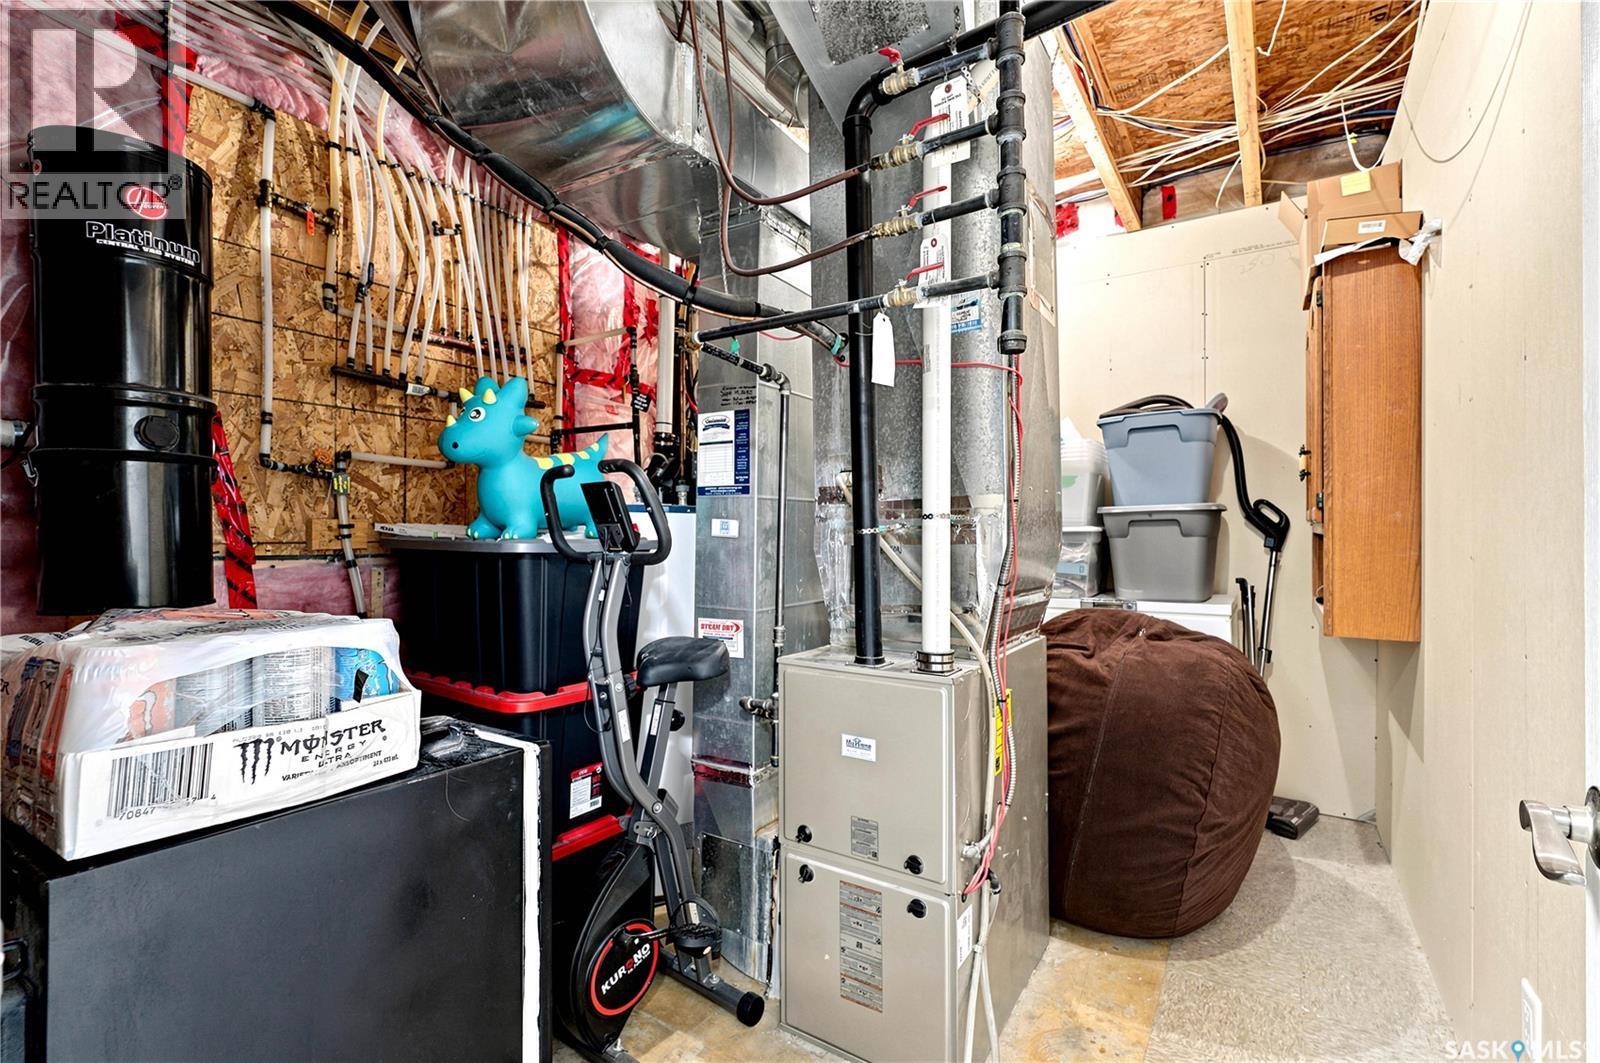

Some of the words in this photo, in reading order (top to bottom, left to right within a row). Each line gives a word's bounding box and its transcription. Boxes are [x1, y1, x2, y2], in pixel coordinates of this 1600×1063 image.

[86, 220, 200, 263] Platinum
[96, 239, 140, 251] CENTRAL
[164, 251, 195, 266] SYSTEM
[318, 752, 352, 768] UTRA
[601, 943, 651, 995] KURONO
